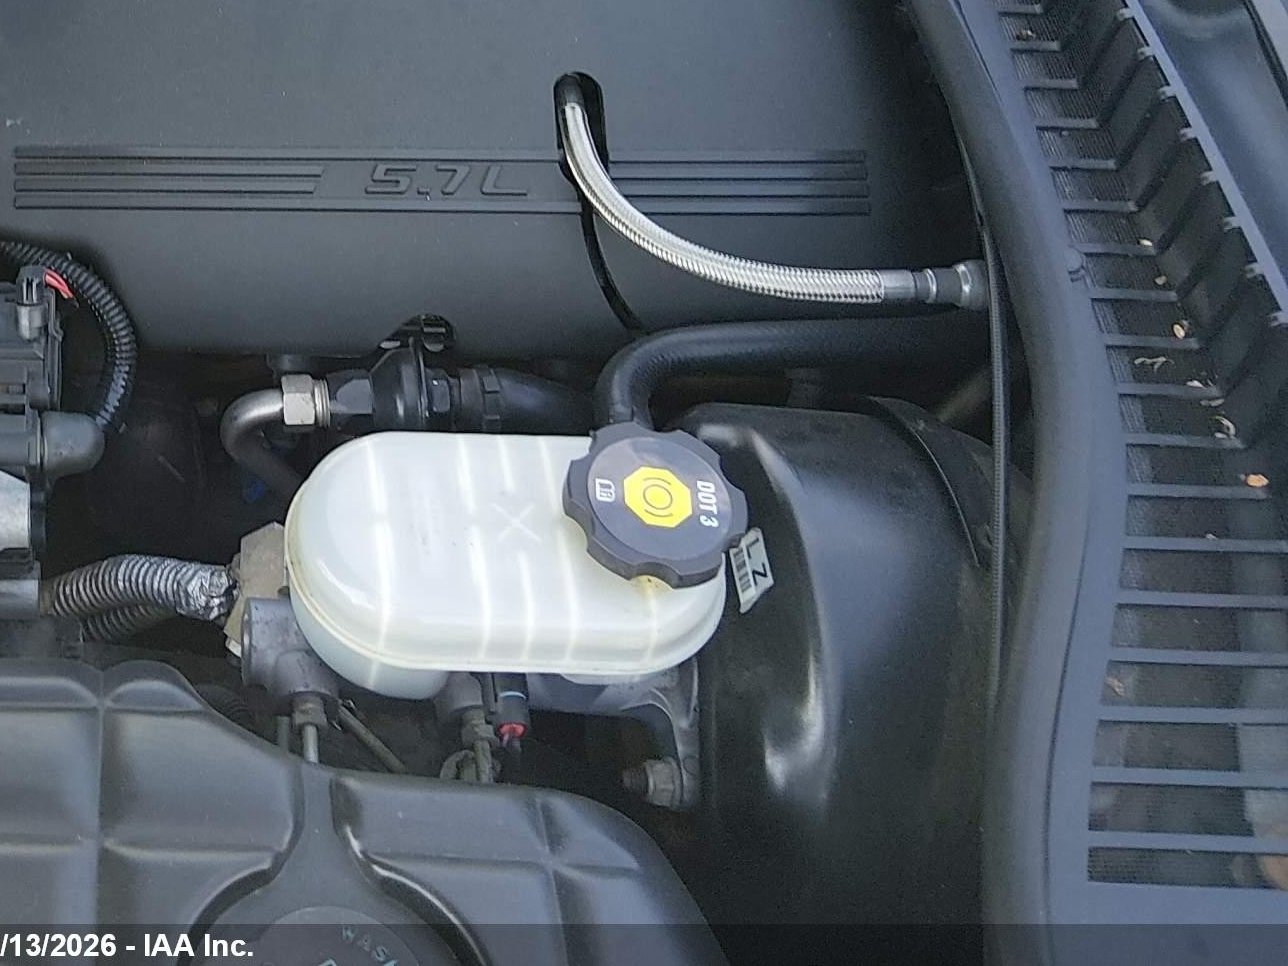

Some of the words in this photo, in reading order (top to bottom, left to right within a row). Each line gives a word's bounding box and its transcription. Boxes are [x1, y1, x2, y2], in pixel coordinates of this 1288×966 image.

[364, 163, 528, 197] 5.7L
[695, 480, 719, 514] DOT
[698, 512, 720, 529] 3
